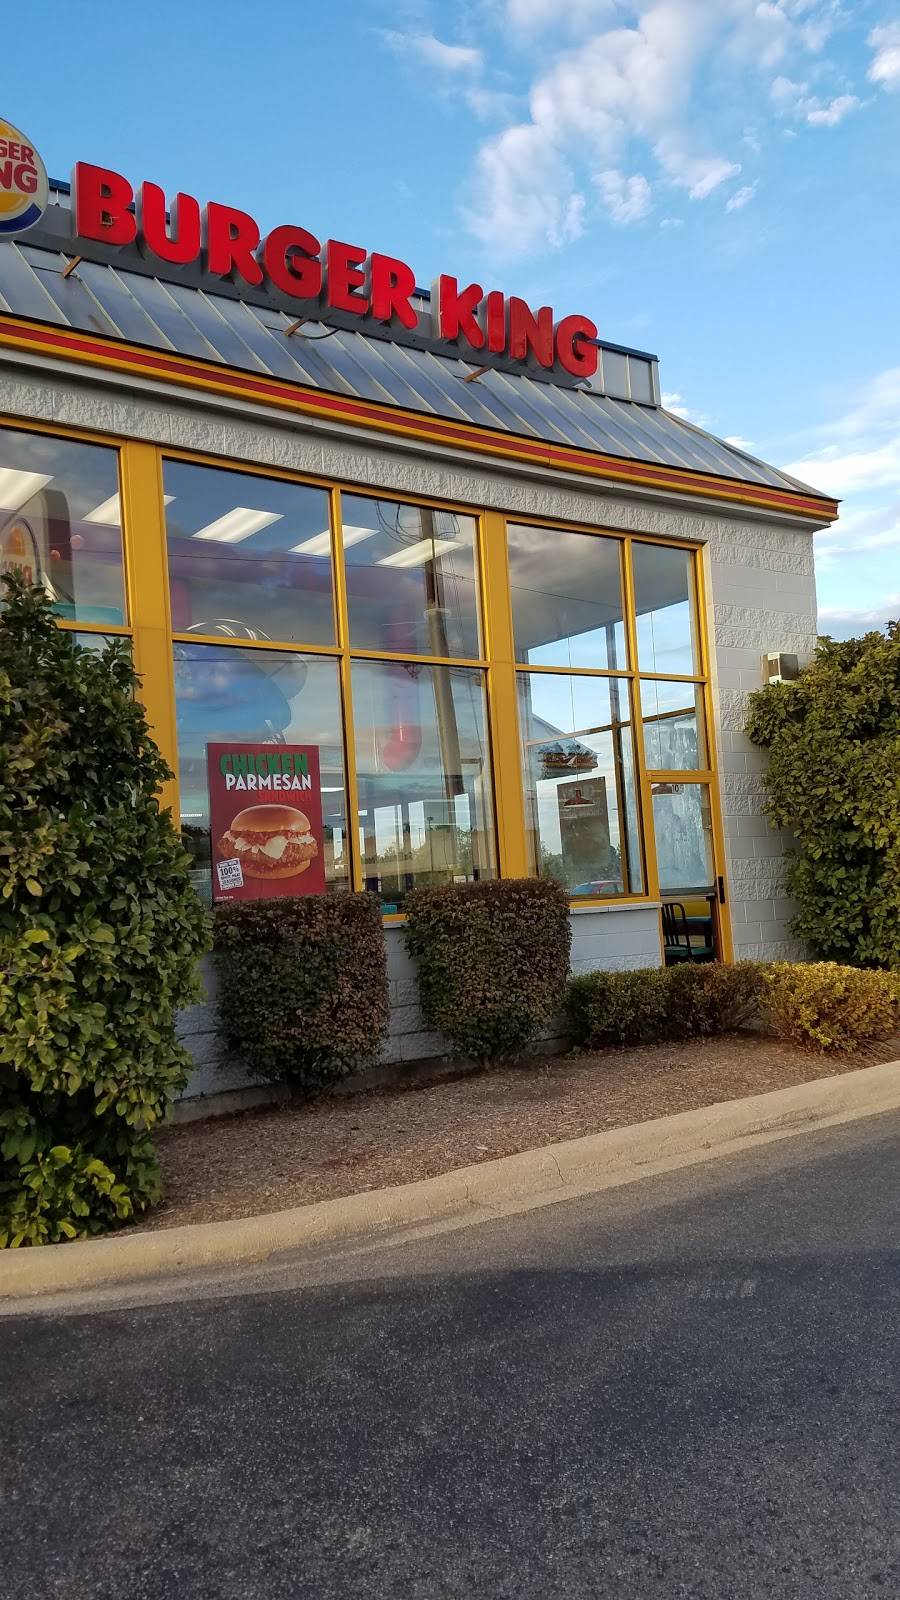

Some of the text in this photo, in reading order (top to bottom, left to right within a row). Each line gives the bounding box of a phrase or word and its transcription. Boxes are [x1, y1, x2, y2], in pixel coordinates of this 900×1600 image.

[72, 161, 599, 378] BURGER KING
[220, 752, 308, 777] CHICKEN
[225, 773, 312, 791] PARMESAN
[220, 866, 240, 876] 100%
